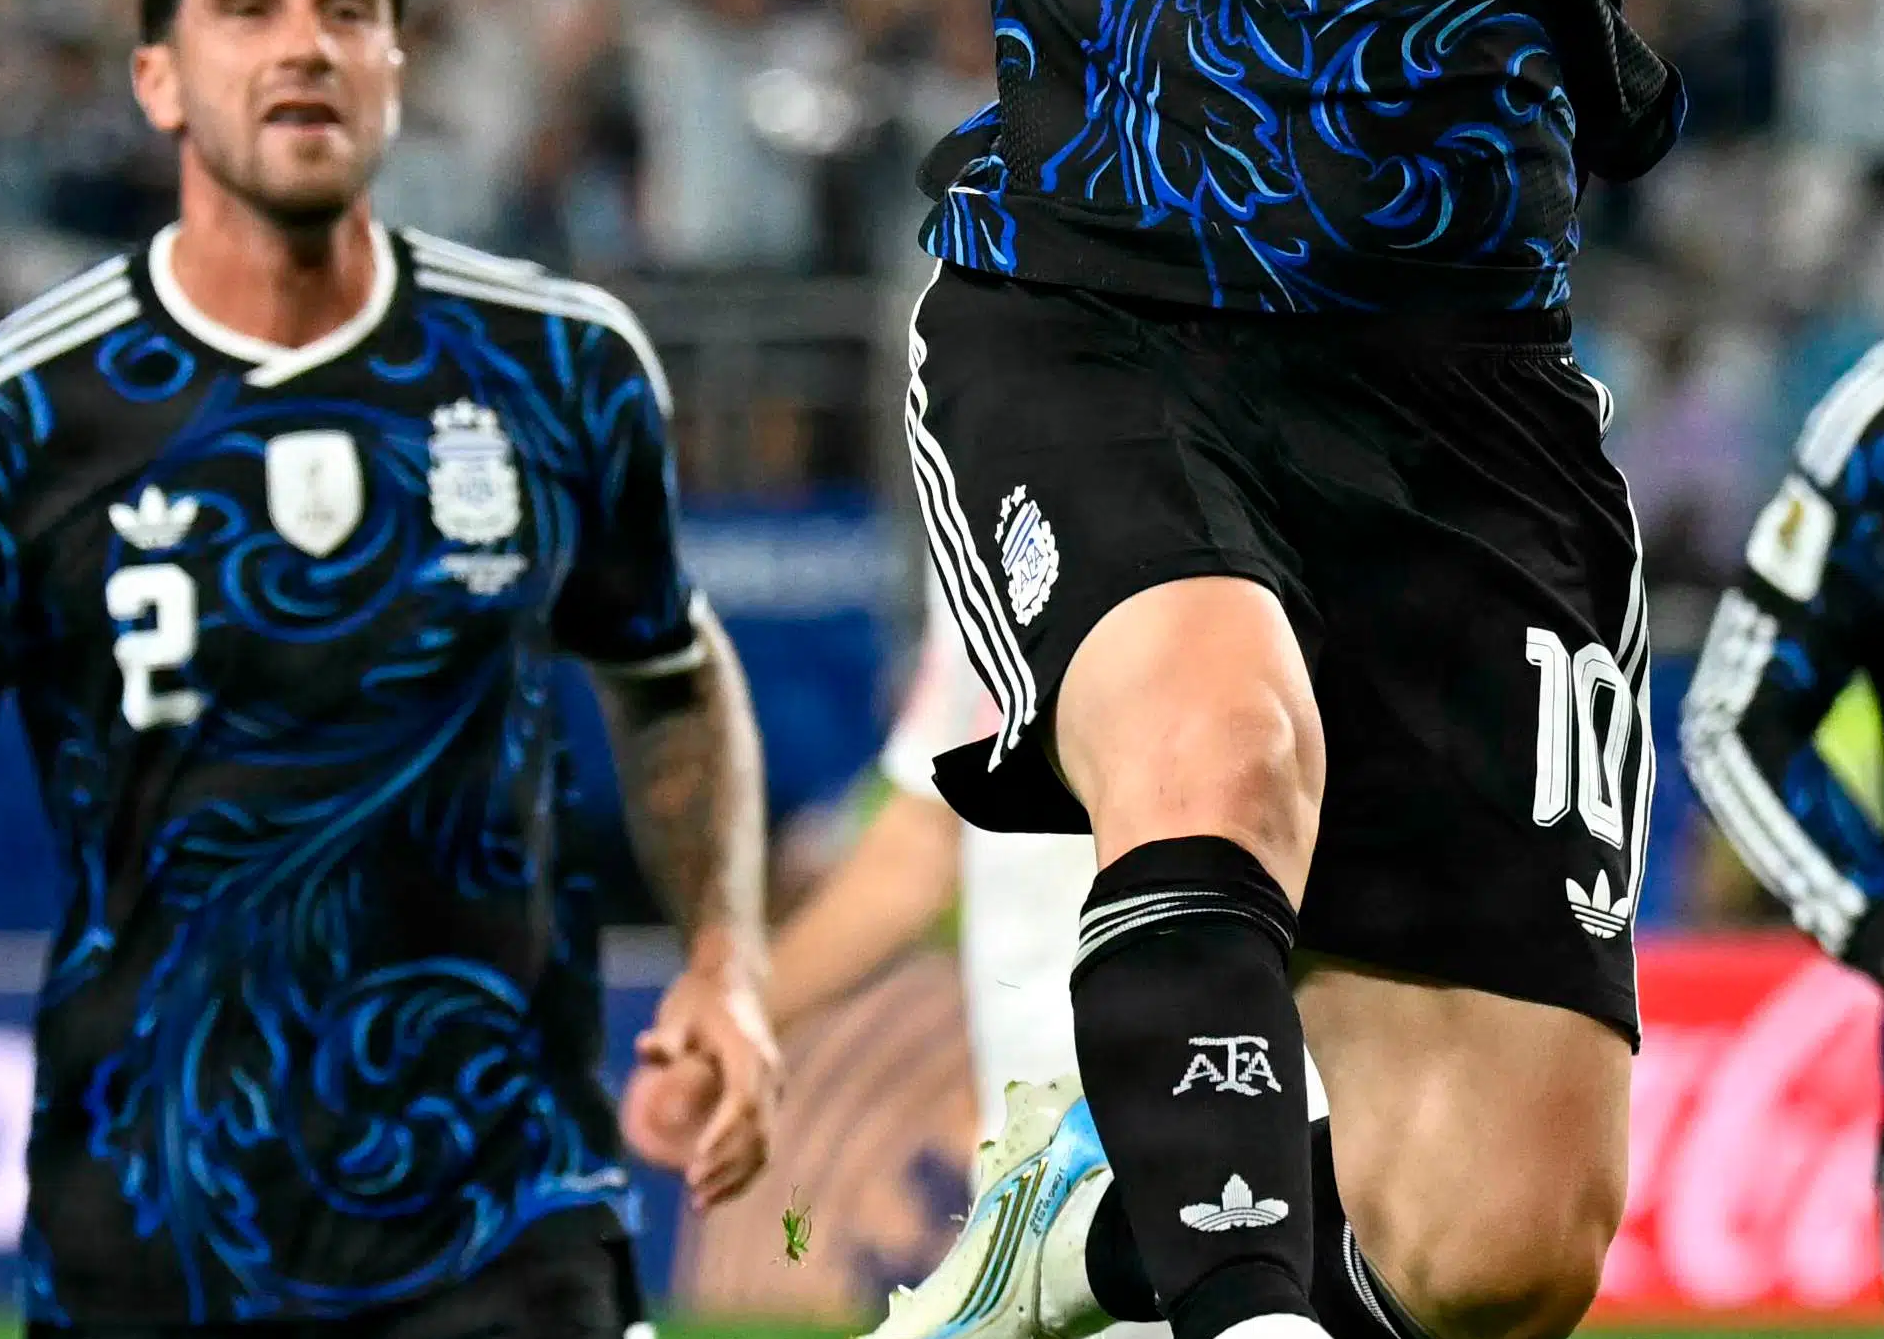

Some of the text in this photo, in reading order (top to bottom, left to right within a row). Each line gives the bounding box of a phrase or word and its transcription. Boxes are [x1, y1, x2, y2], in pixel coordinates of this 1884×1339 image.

[1019, 537, 1045, 594] AFA
[104, 562, 205, 733] 2
[1525, 625, 1624, 850] 10
[1173, 1035, 1282, 1096] AFA
